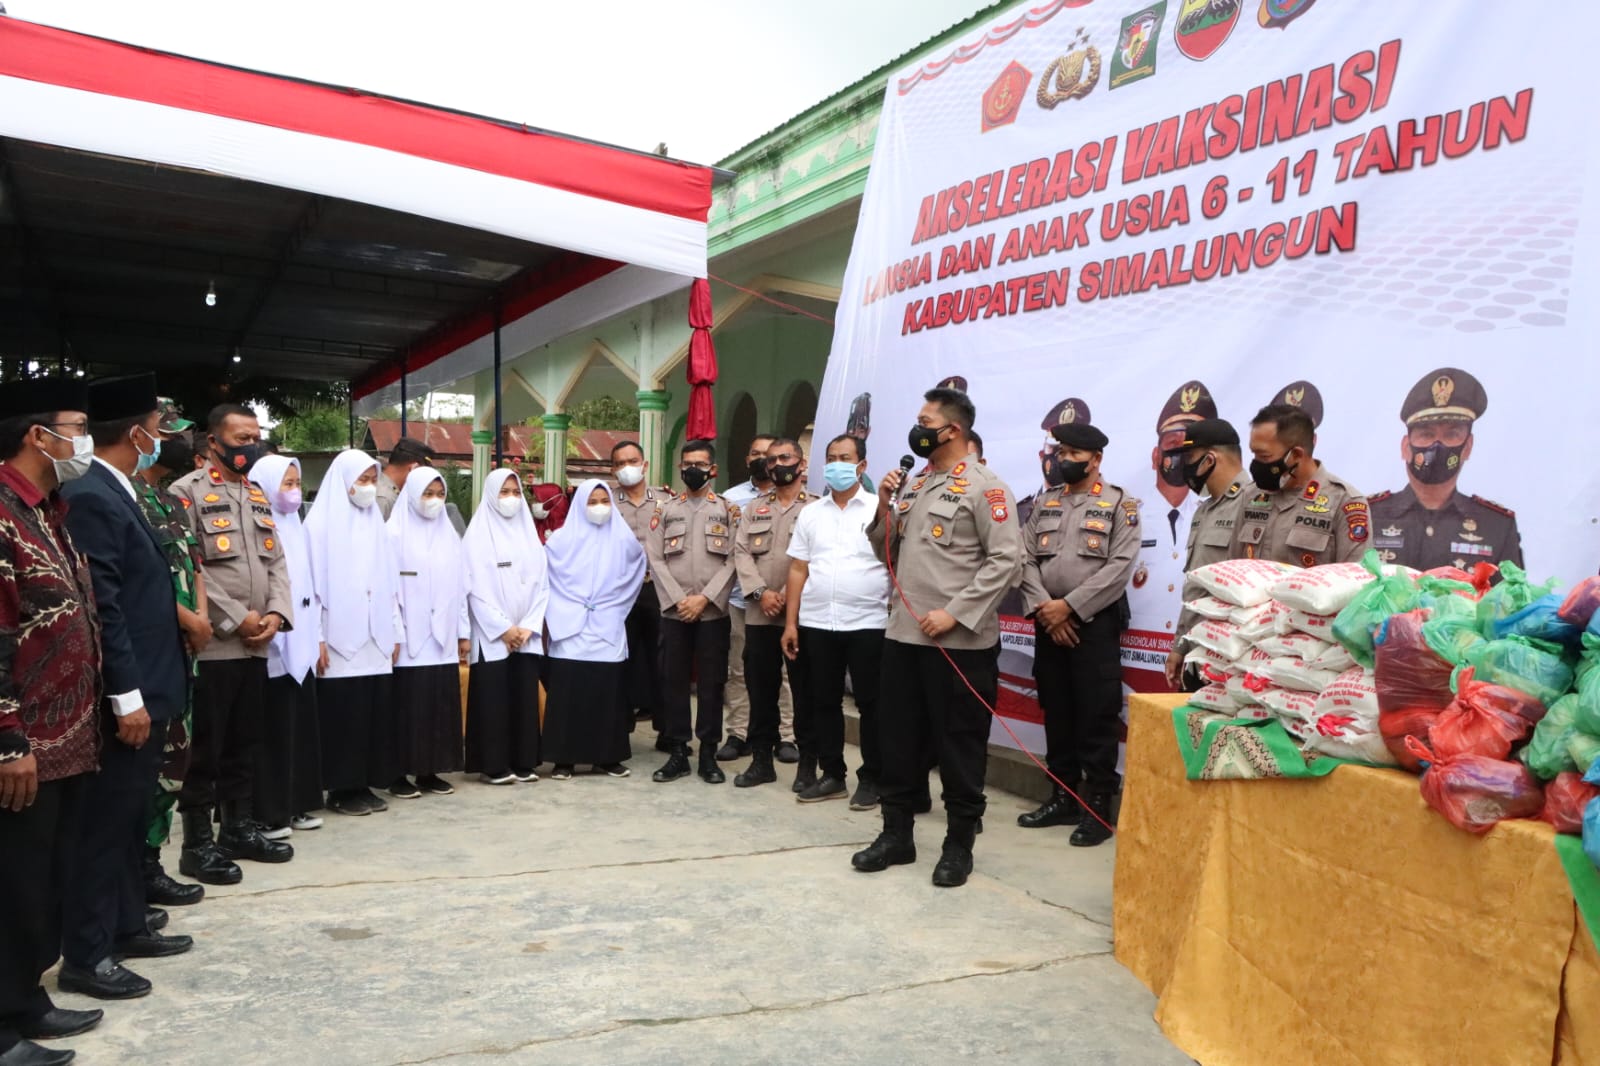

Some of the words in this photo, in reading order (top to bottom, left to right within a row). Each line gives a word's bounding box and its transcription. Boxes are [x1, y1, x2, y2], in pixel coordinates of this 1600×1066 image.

[911, 135, 1118, 246] AKSELERASI
[1121, 38, 1402, 184] VAKSINASI
[863, 252, 932, 306] LANSIA
[937, 233, 996, 280] DAN
[997, 207, 1094, 266] ANAK
[1100, 184, 1190, 242] USIA
[1201, 174, 1229, 219] 6
[1266, 149, 1318, 204] 11
[1333, 87, 1534, 182] TAHUN
[901, 267, 1070, 336] KABUPATEN
[1076, 201, 1358, 303] SIMALUNGUN
[1295, 515, 1331, 530] POLRI
[1002, 633, 1024, 645] KAPOLRES
[1131, 650, 1167, 665] SIMALUNGUN
